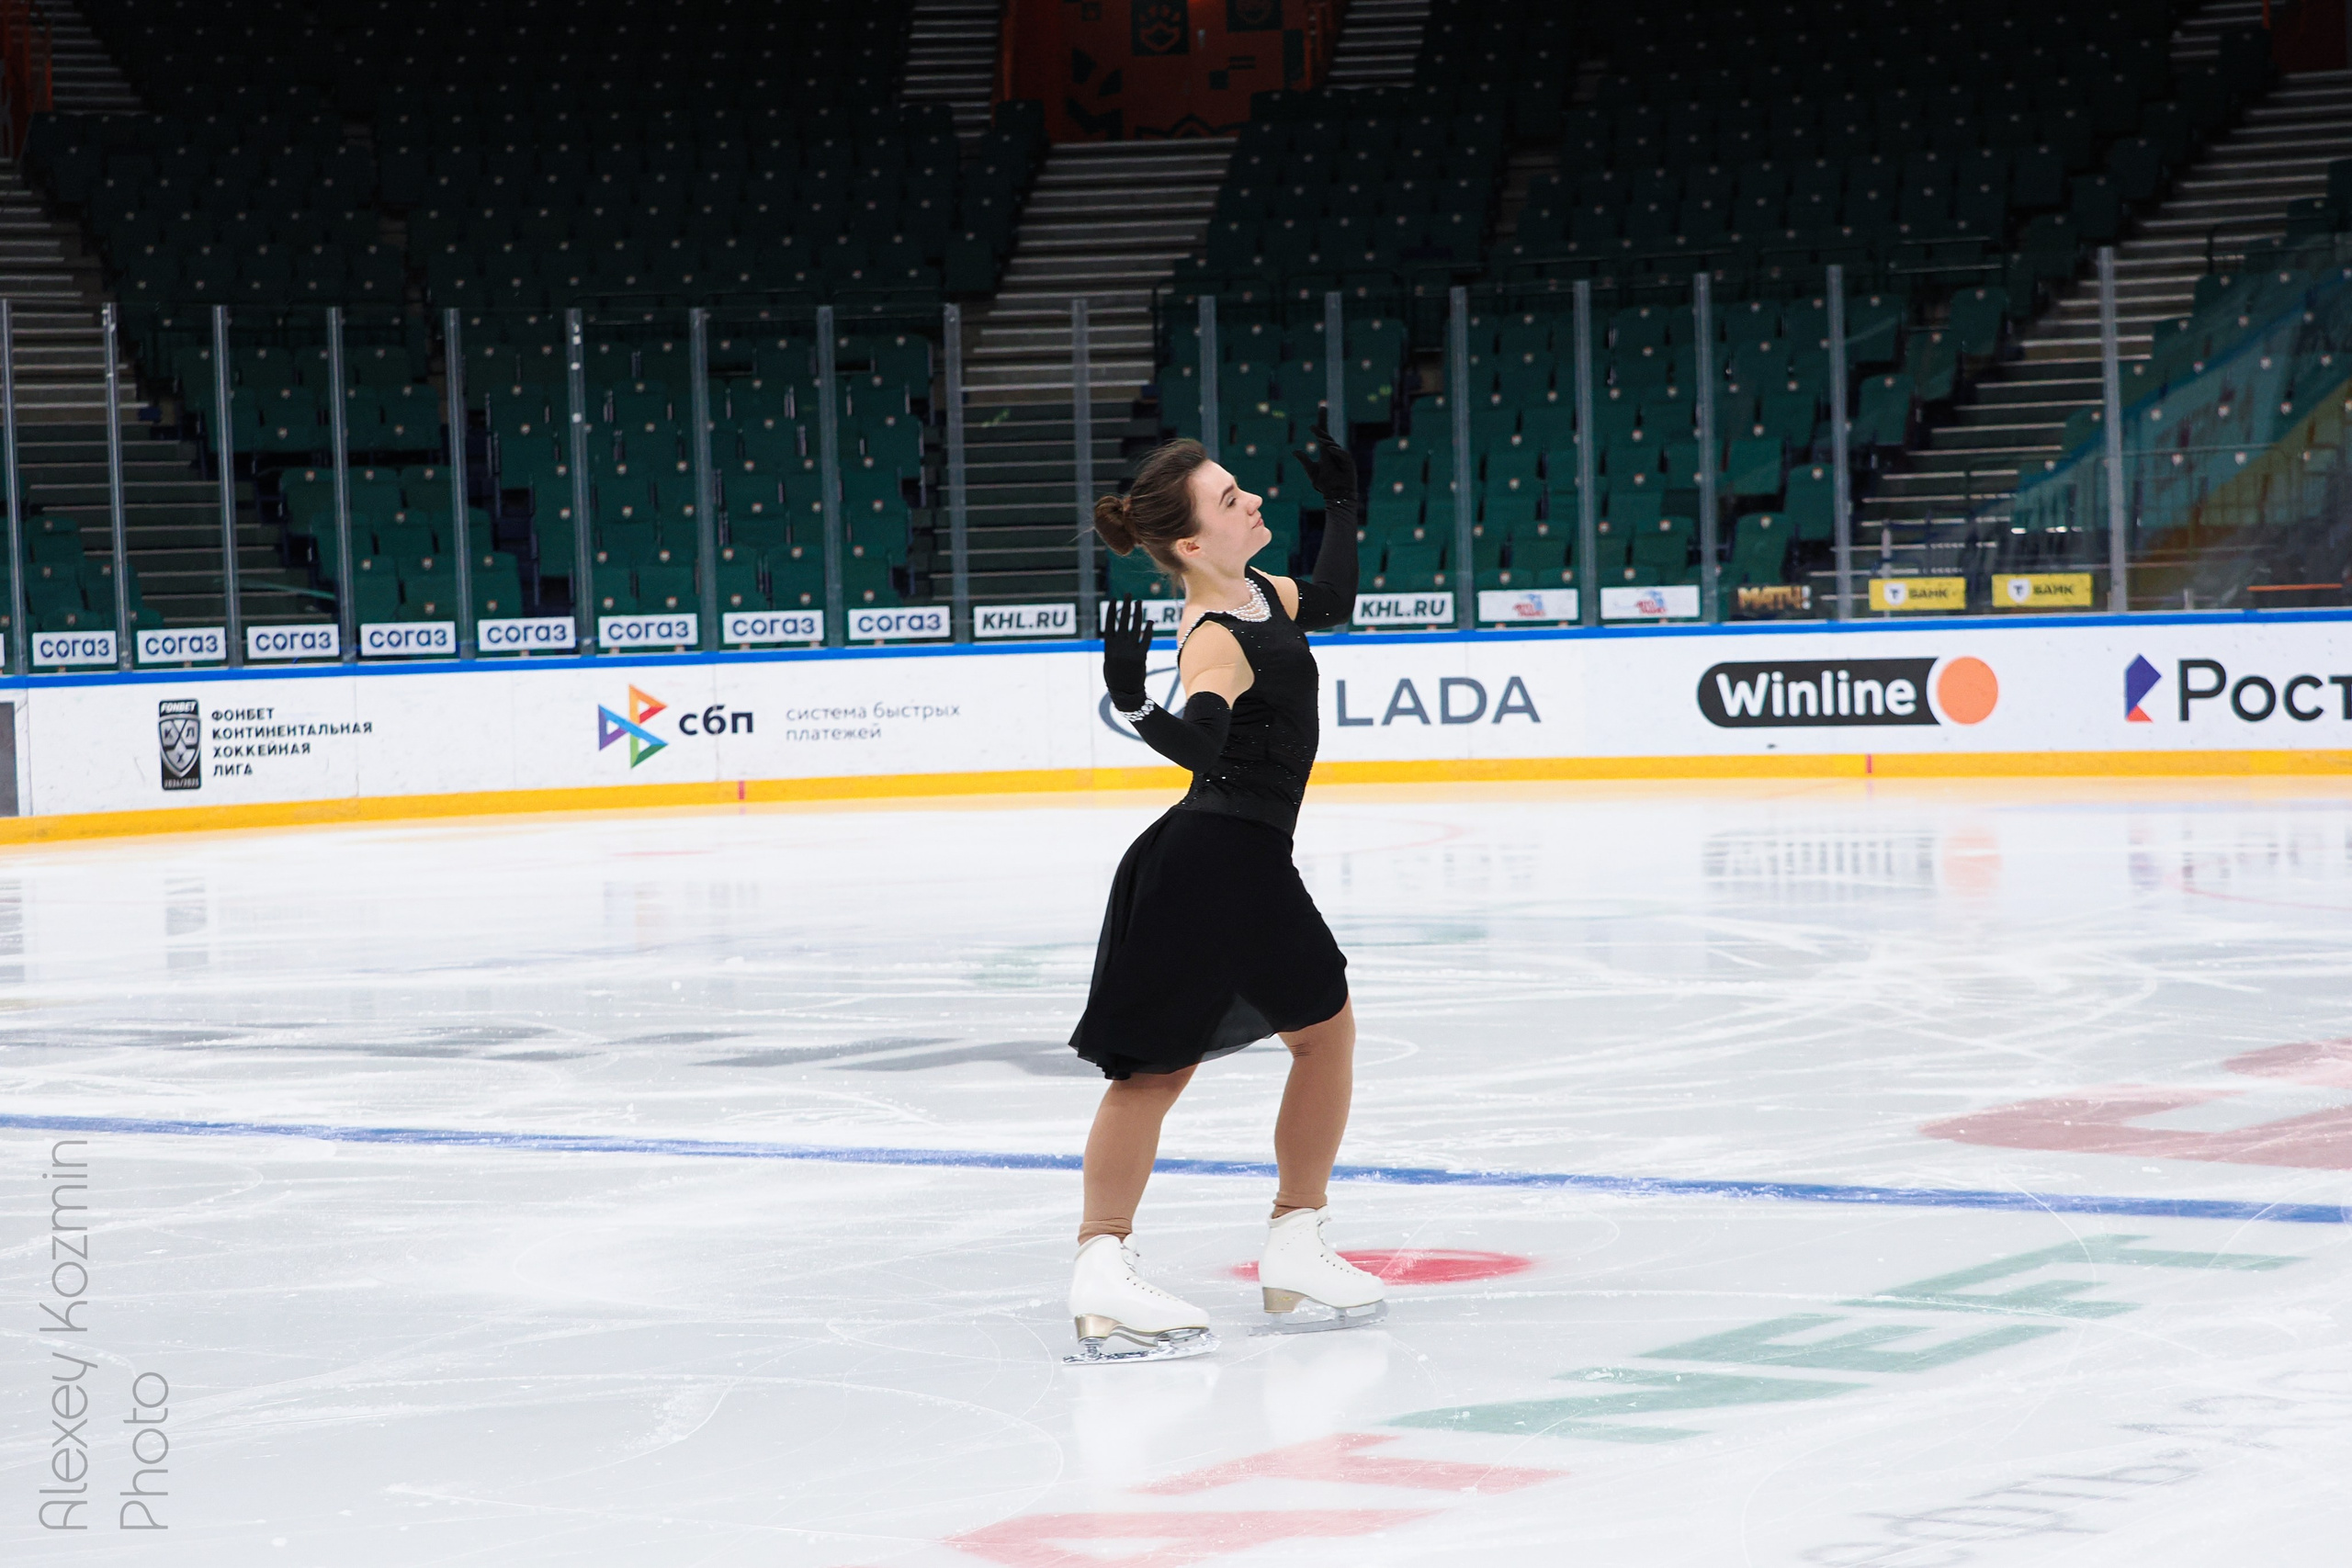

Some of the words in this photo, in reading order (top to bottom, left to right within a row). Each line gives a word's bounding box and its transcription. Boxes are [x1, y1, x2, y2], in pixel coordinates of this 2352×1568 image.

[1360, 599, 1447, 619] KHL.RU
[606, 619, 690, 641] согаз
[731, 616, 815, 637] согаз
[856, 613, 942, 635] согаз
[981, 610, 1069, 630] KHL.RU
[254, 630, 333, 652] согаз
[368, 627, 447, 649] согаз
[486, 623, 568, 644] согаз
[40, 637, 111, 660] согаз
[144, 633, 220, 656] согаз
[1336, 675, 1542, 728] LADA
[1714, 670, 1917, 718] Winline
[211, 708, 275, 722] ФОНБЕТ
[679, 705, 753, 736] сбп
[785, 705, 867, 721] система
[873, 700, 960, 720] быстрых
[212, 722, 373, 740] КОНТИНЕНТАЛЬНАЯ
[785, 722, 883, 742] платежей
[213, 741, 311, 759] ХОККЕЙНАЯ
[213, 763, 254, 777] ЛИГА
